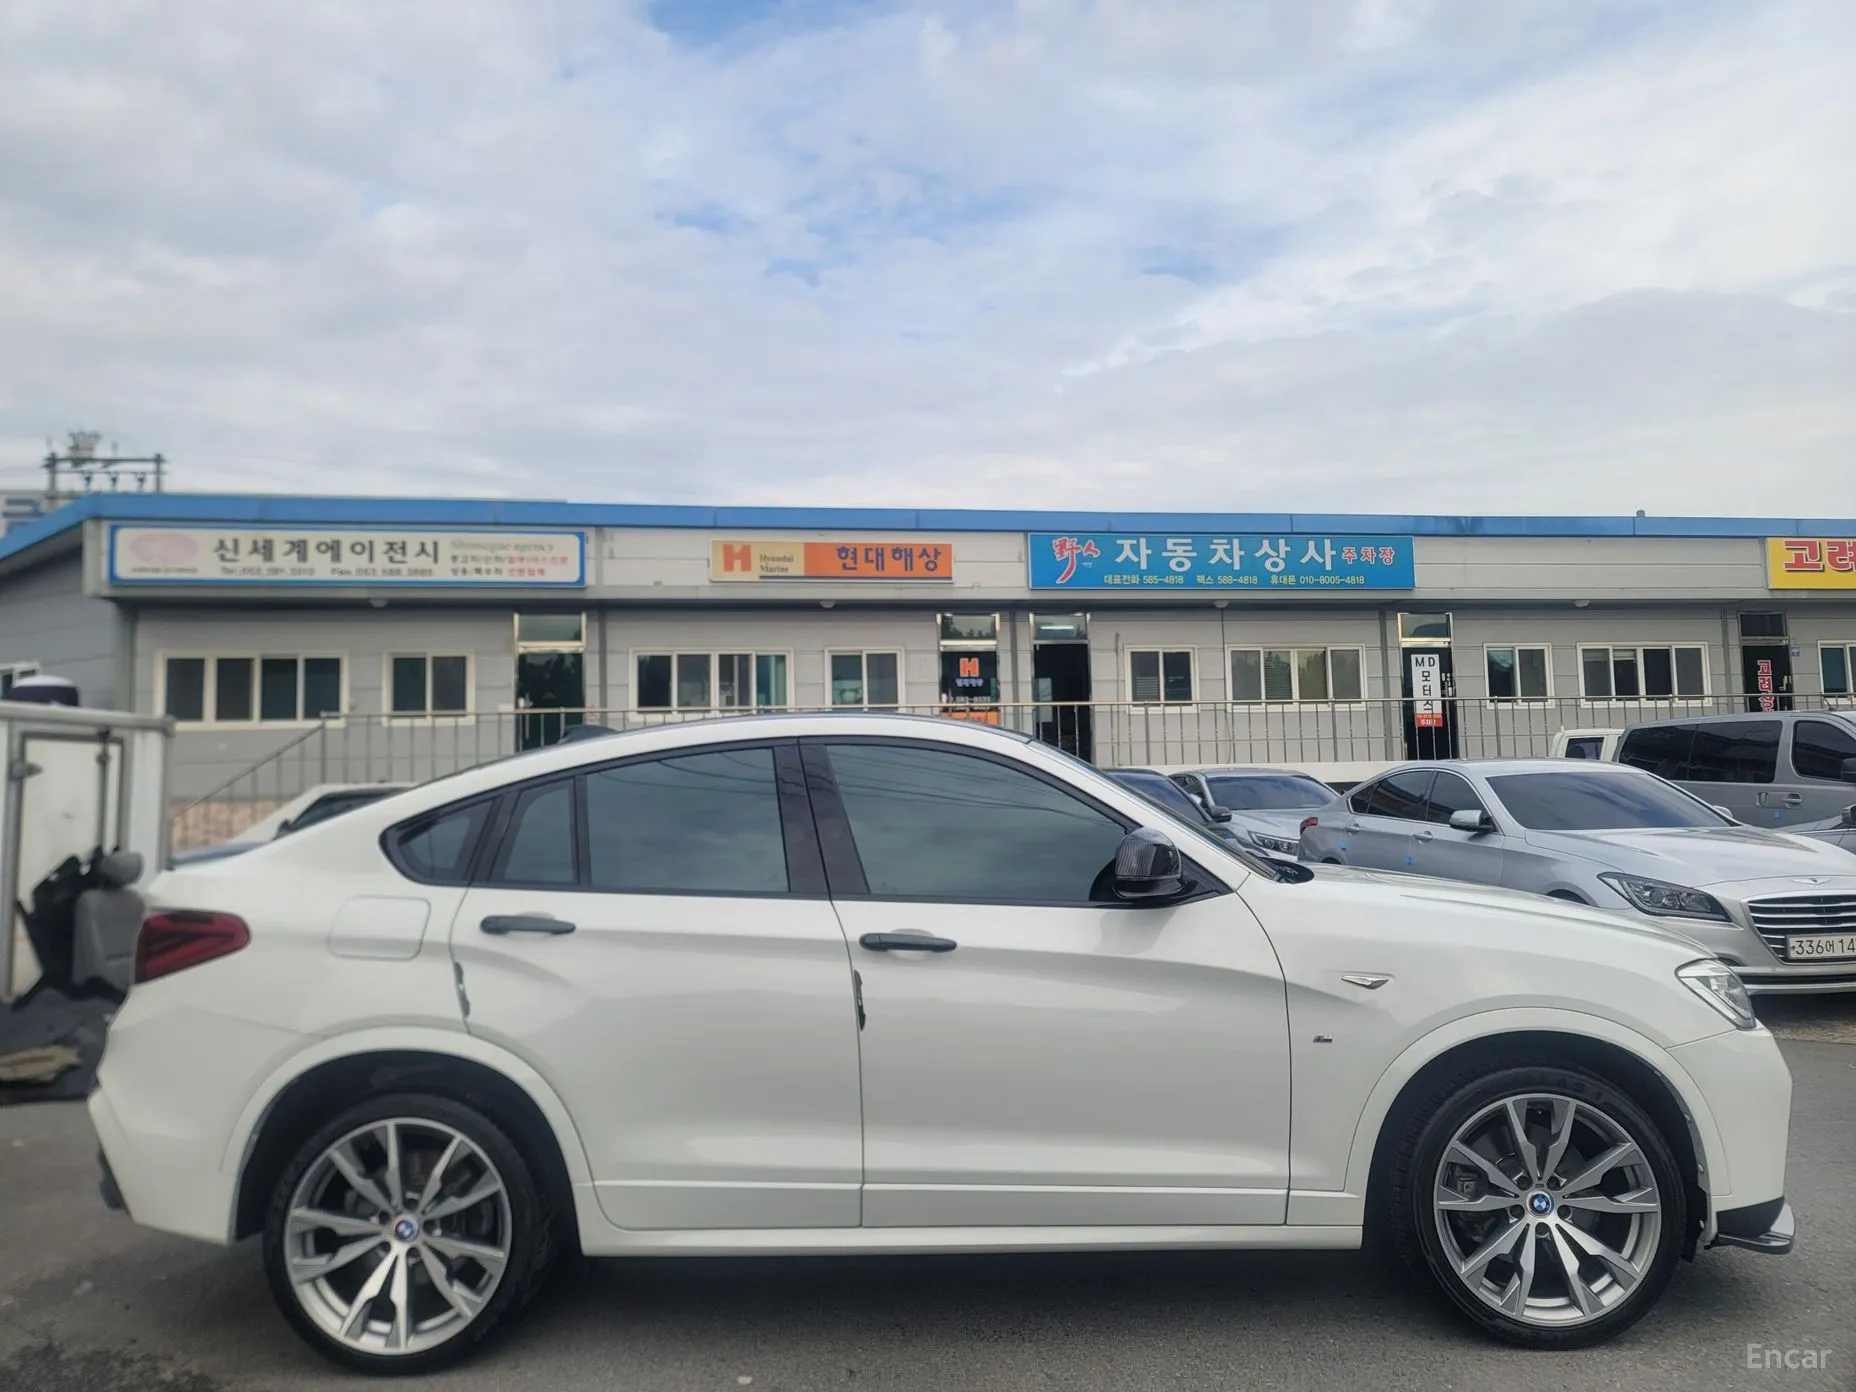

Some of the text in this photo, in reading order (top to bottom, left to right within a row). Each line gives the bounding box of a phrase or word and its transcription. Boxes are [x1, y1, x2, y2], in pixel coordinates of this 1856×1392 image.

[213, 537, 440, 564] 신세계에이전시
[836, 546, 943, 573] 현대해상
[1115, 538, 1396, 573] 자동차상사 주차장
[759, 564, 789, 574] Marine
[1103, 574, 1140, 585] 대표전화
[1143, 576, 1185, 585] 585-4818
[1270, 574, 1297, 585] 휴대폰
[1299, 576, 1365, 585] 010-8005-4818
[1415, 657, 1436, 667] MD
[1422, 670, 1433, 710] 모터스
[1795, 938, 1856, 955] 336어 14
